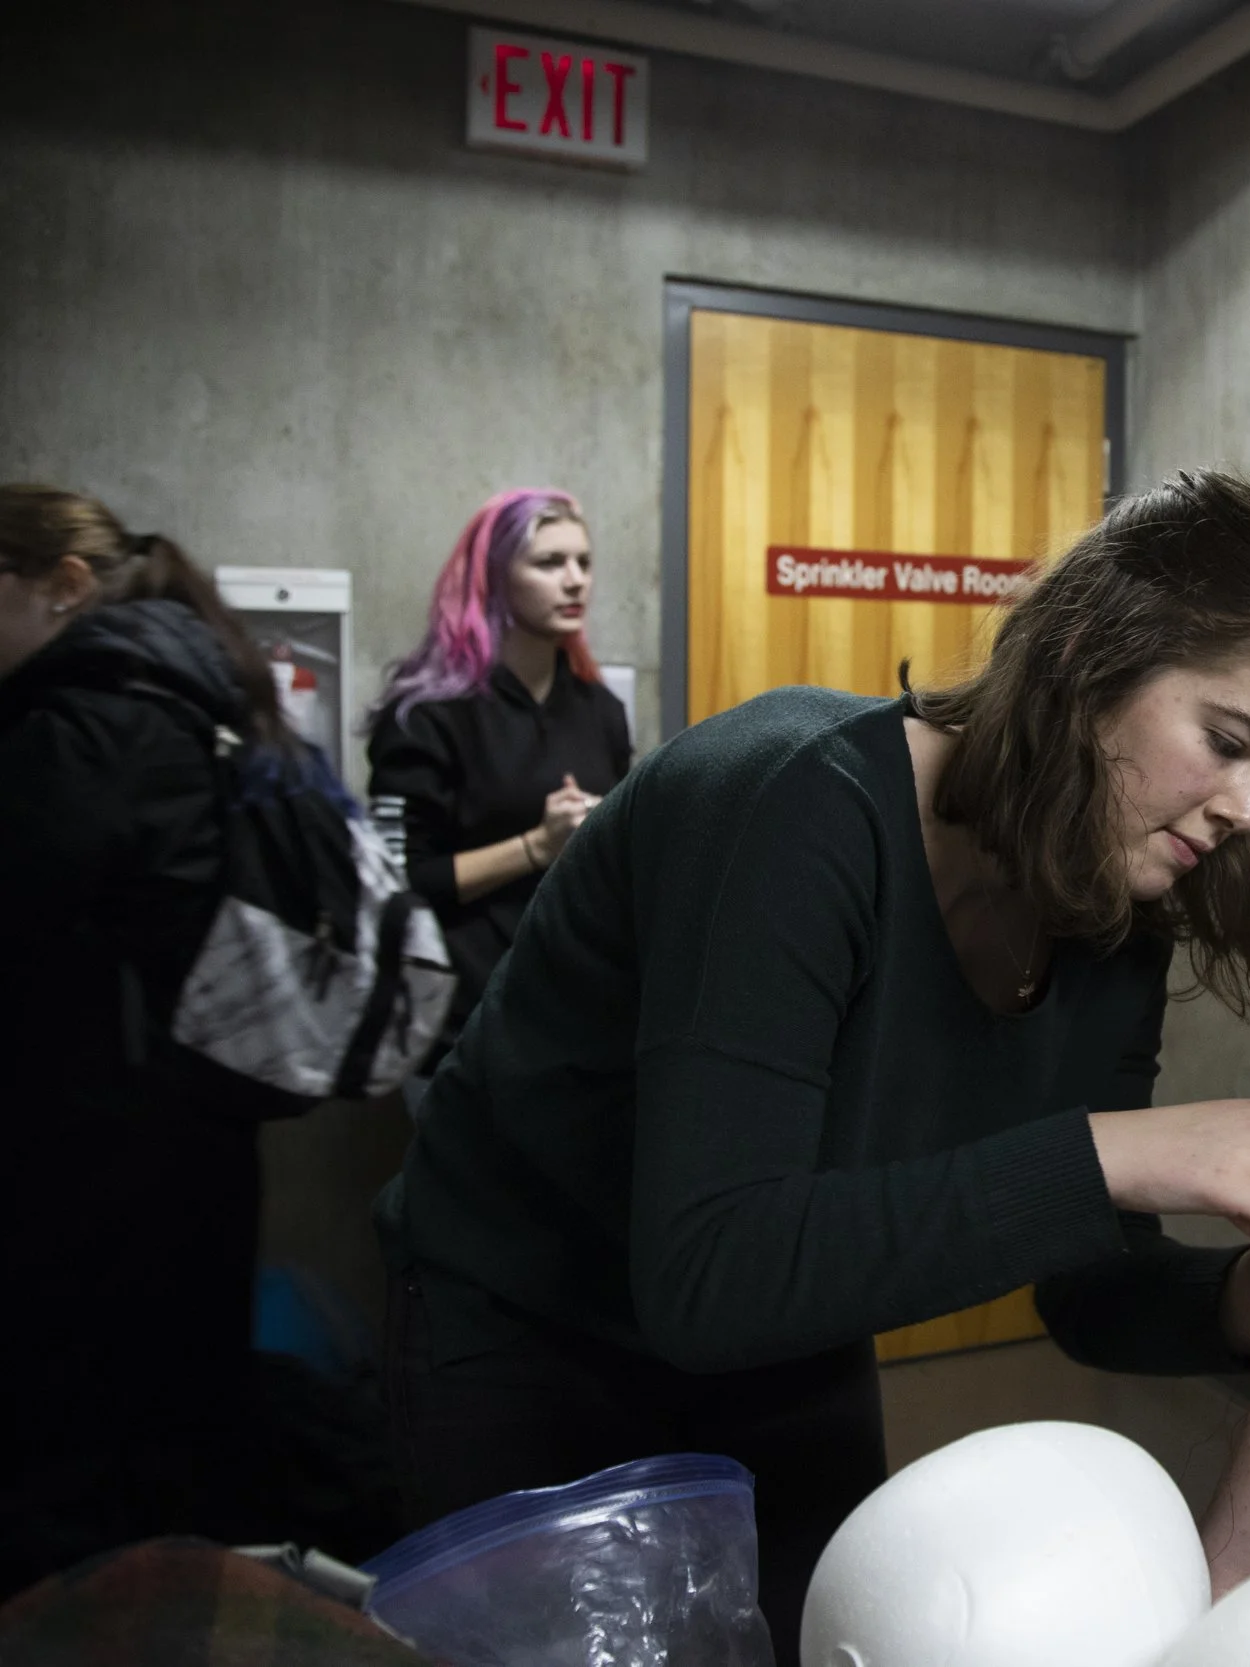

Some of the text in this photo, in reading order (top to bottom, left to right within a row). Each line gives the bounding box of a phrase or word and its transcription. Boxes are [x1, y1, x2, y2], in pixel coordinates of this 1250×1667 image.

[495, 43, 637, 146] EXIT
[776, 554, 889, 593] Sprinkler
[893, 562, 958, 595] Valve
